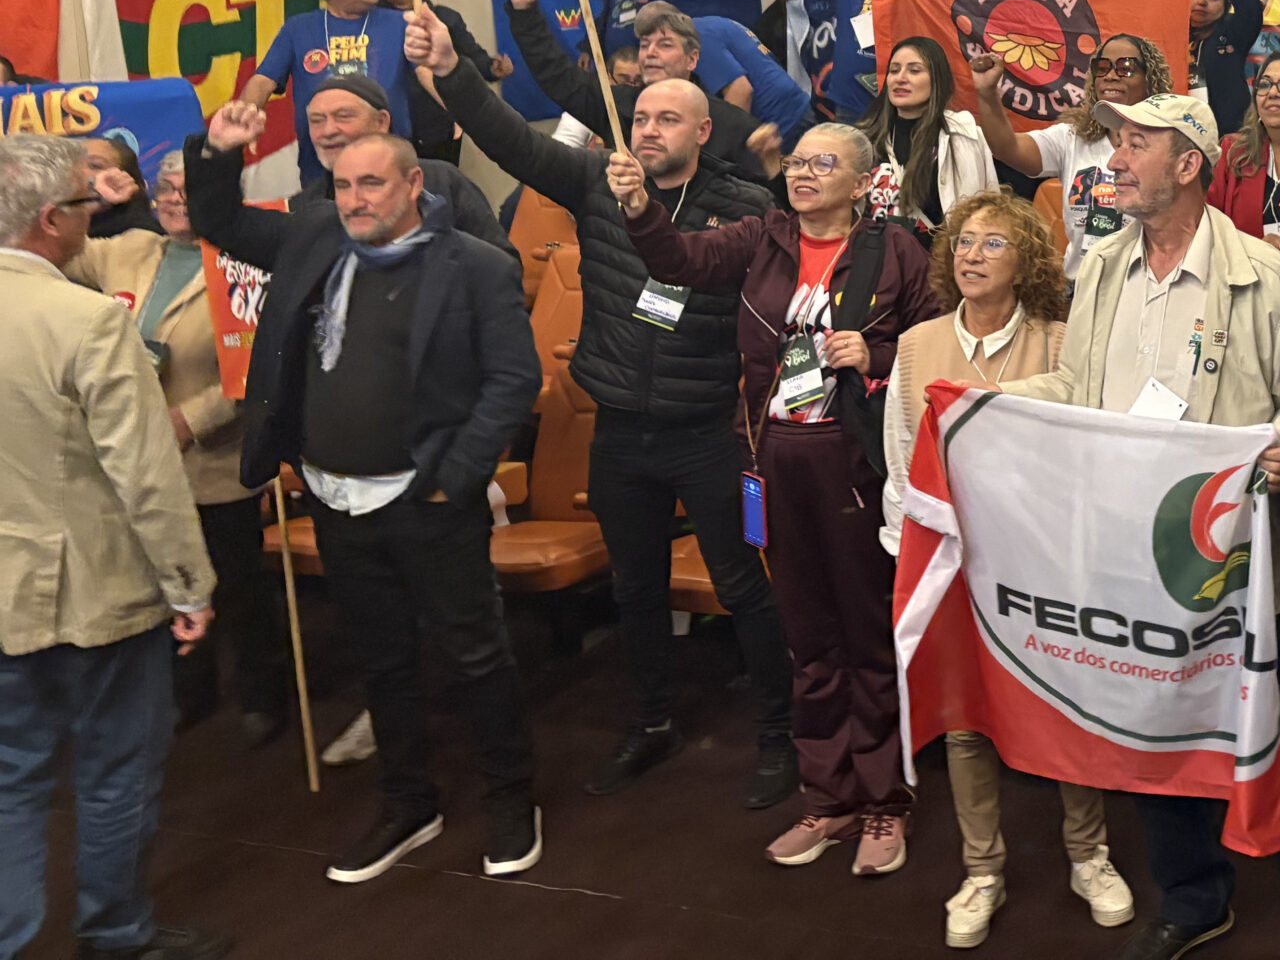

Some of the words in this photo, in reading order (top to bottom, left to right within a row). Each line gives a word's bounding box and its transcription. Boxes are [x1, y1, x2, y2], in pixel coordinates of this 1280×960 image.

[330, 34, 369, 49] PELO
[330, 47, 367, 65] FIM
[966, 42, 1088, 116] SNDICAL
[0, 85, 101, 136] AIS
[997, 583, 1277, 672] FECOSL
[1025, 634, 1039, 651] A
[1042, 643, 1071, 662] voz
[1074, 647, 1107, 670] dos
